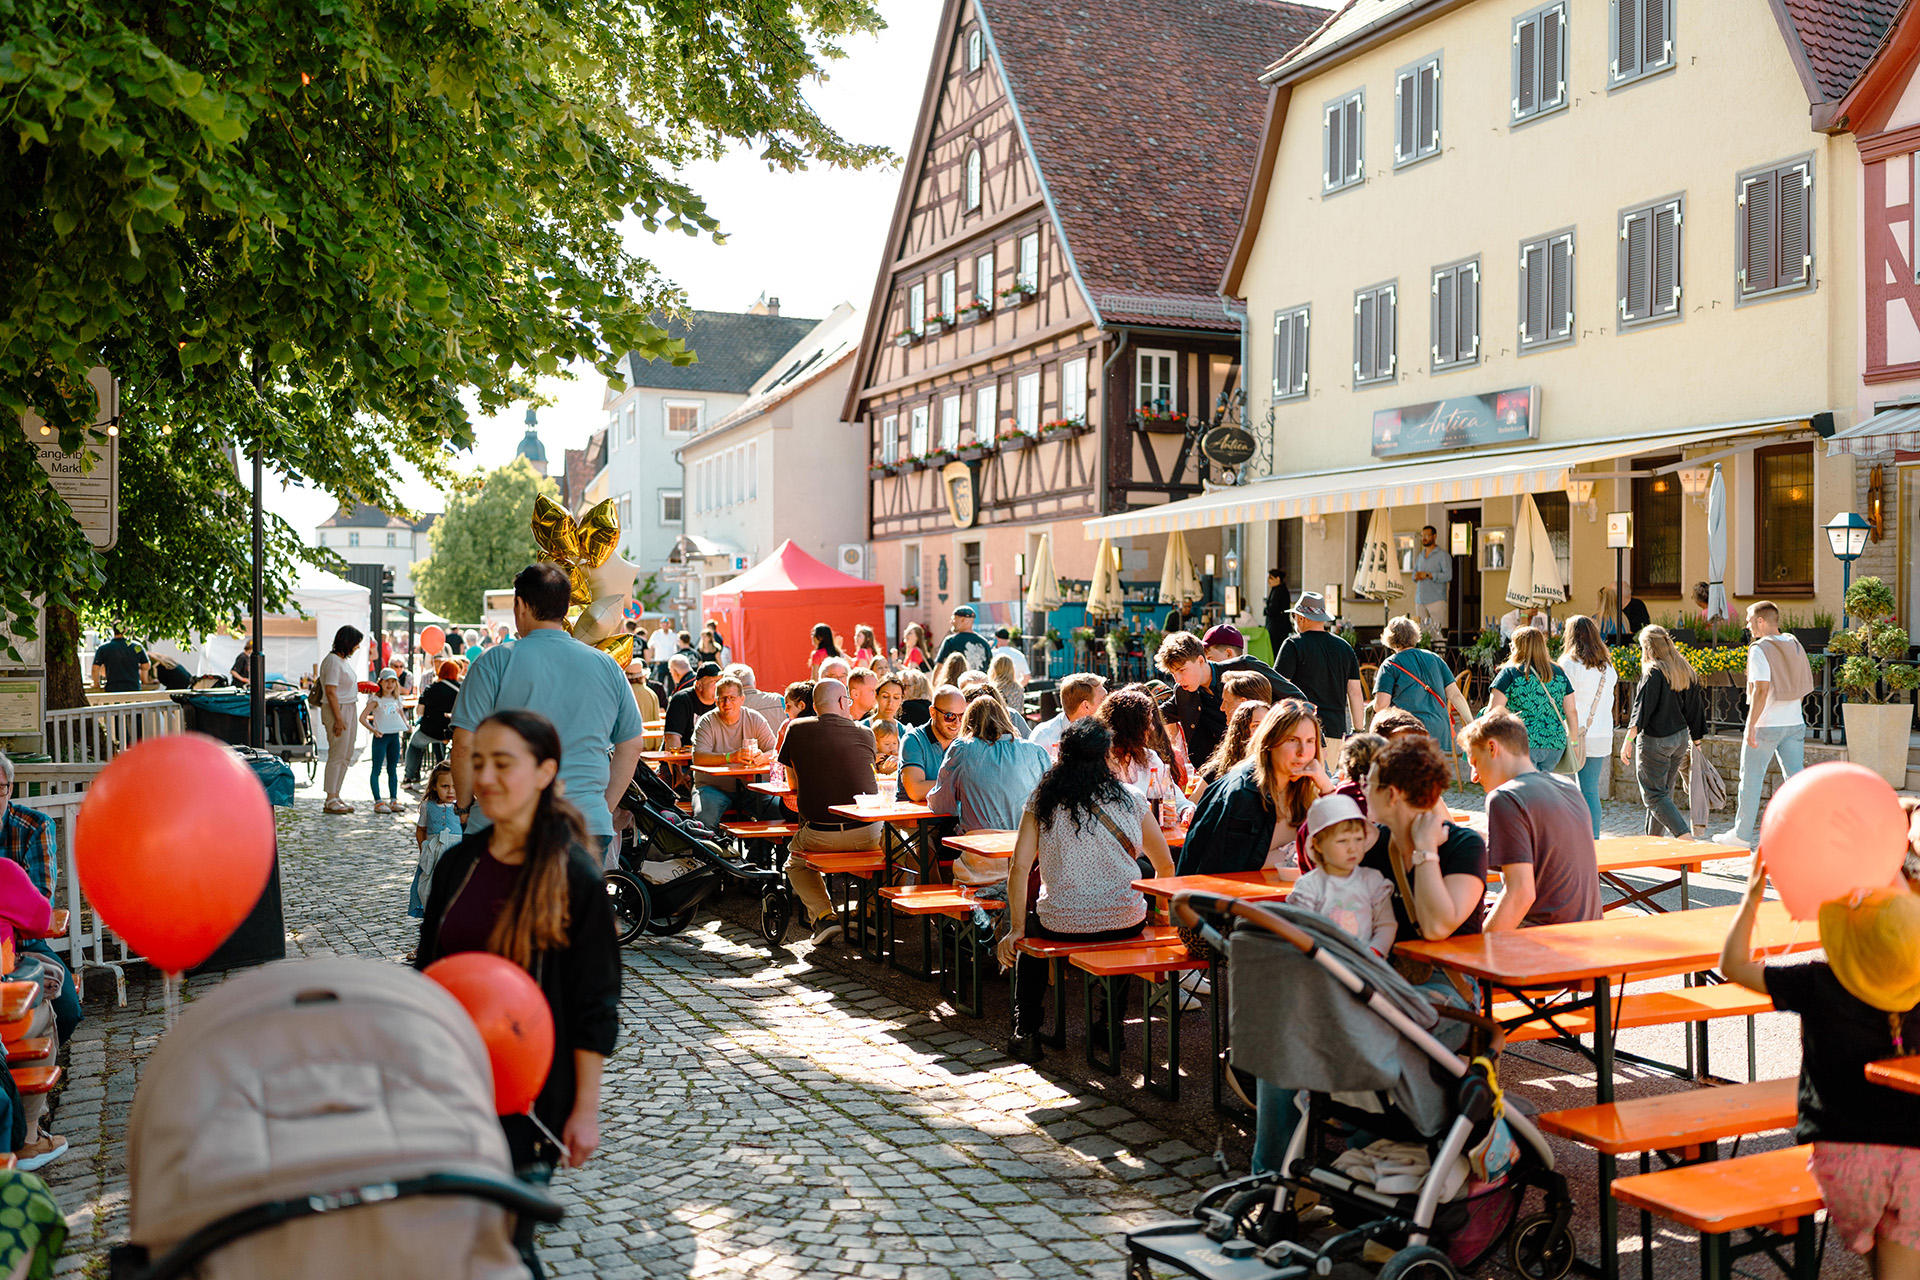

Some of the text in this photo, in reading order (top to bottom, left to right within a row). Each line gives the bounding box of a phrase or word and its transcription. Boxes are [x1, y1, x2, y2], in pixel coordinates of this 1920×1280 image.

[1407, 401, 1488, 439] Antica
[1206, 434, 1253, 450] Antica
[51, 463, 82, 473] Markt
